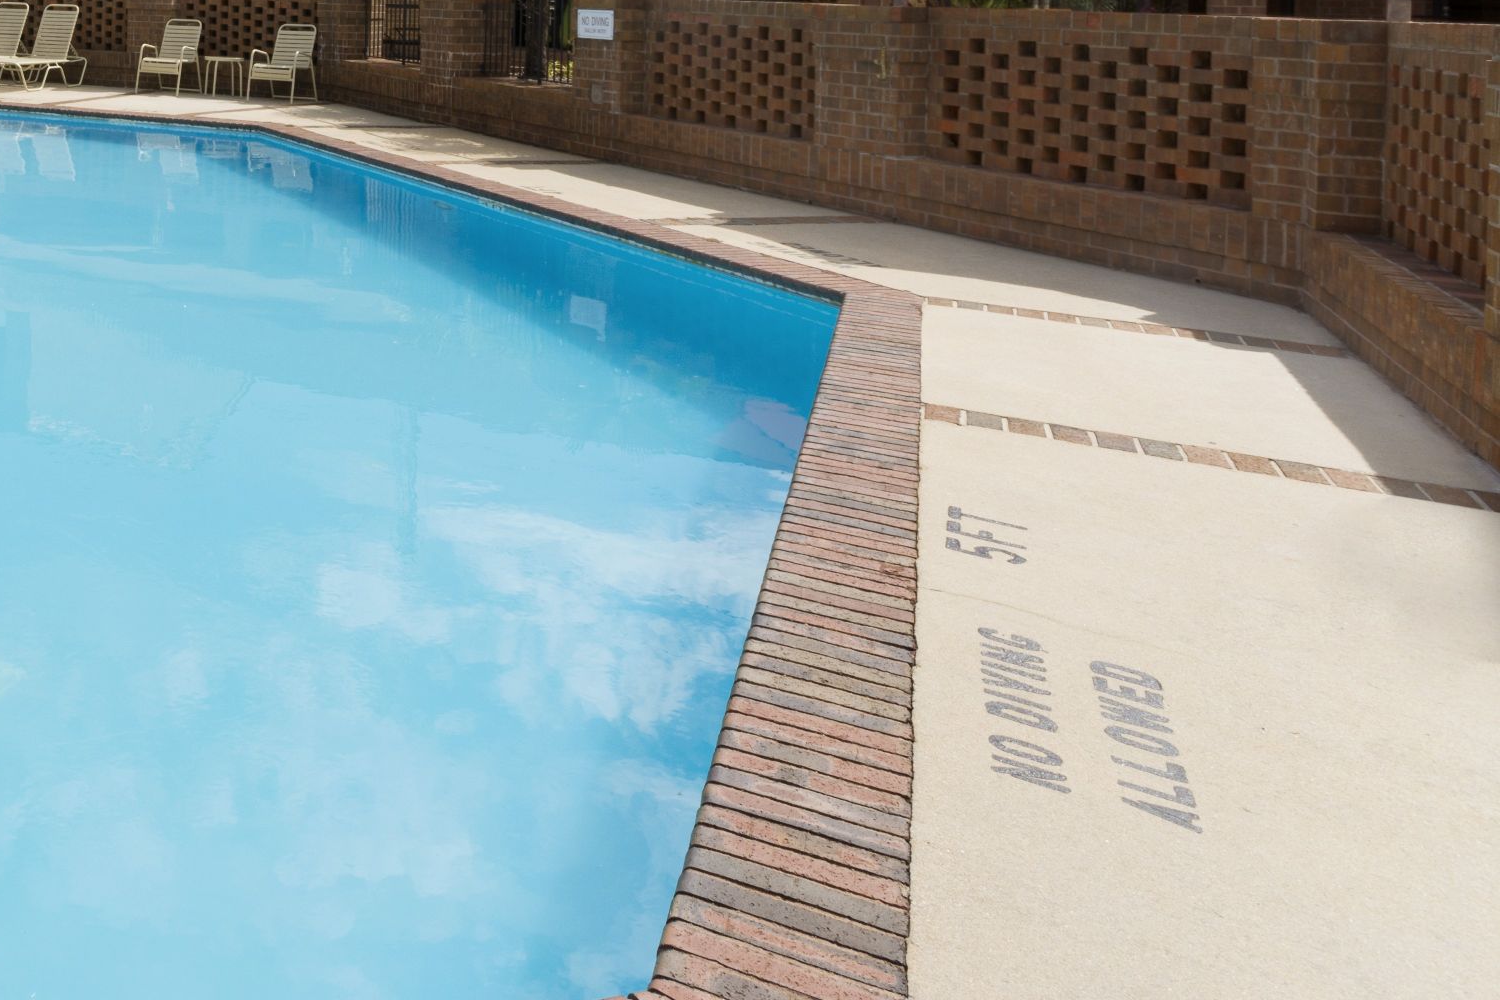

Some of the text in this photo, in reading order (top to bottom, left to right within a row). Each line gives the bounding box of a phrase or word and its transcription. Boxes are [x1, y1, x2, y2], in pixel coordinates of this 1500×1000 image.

[581, 16, 610, 27] NO DIVING
[945, 506, 1028, 565] 5FT
[977, 627, 1072, 794] NO DIVING
[1089, 660, 1204, 835] ALLOWED
